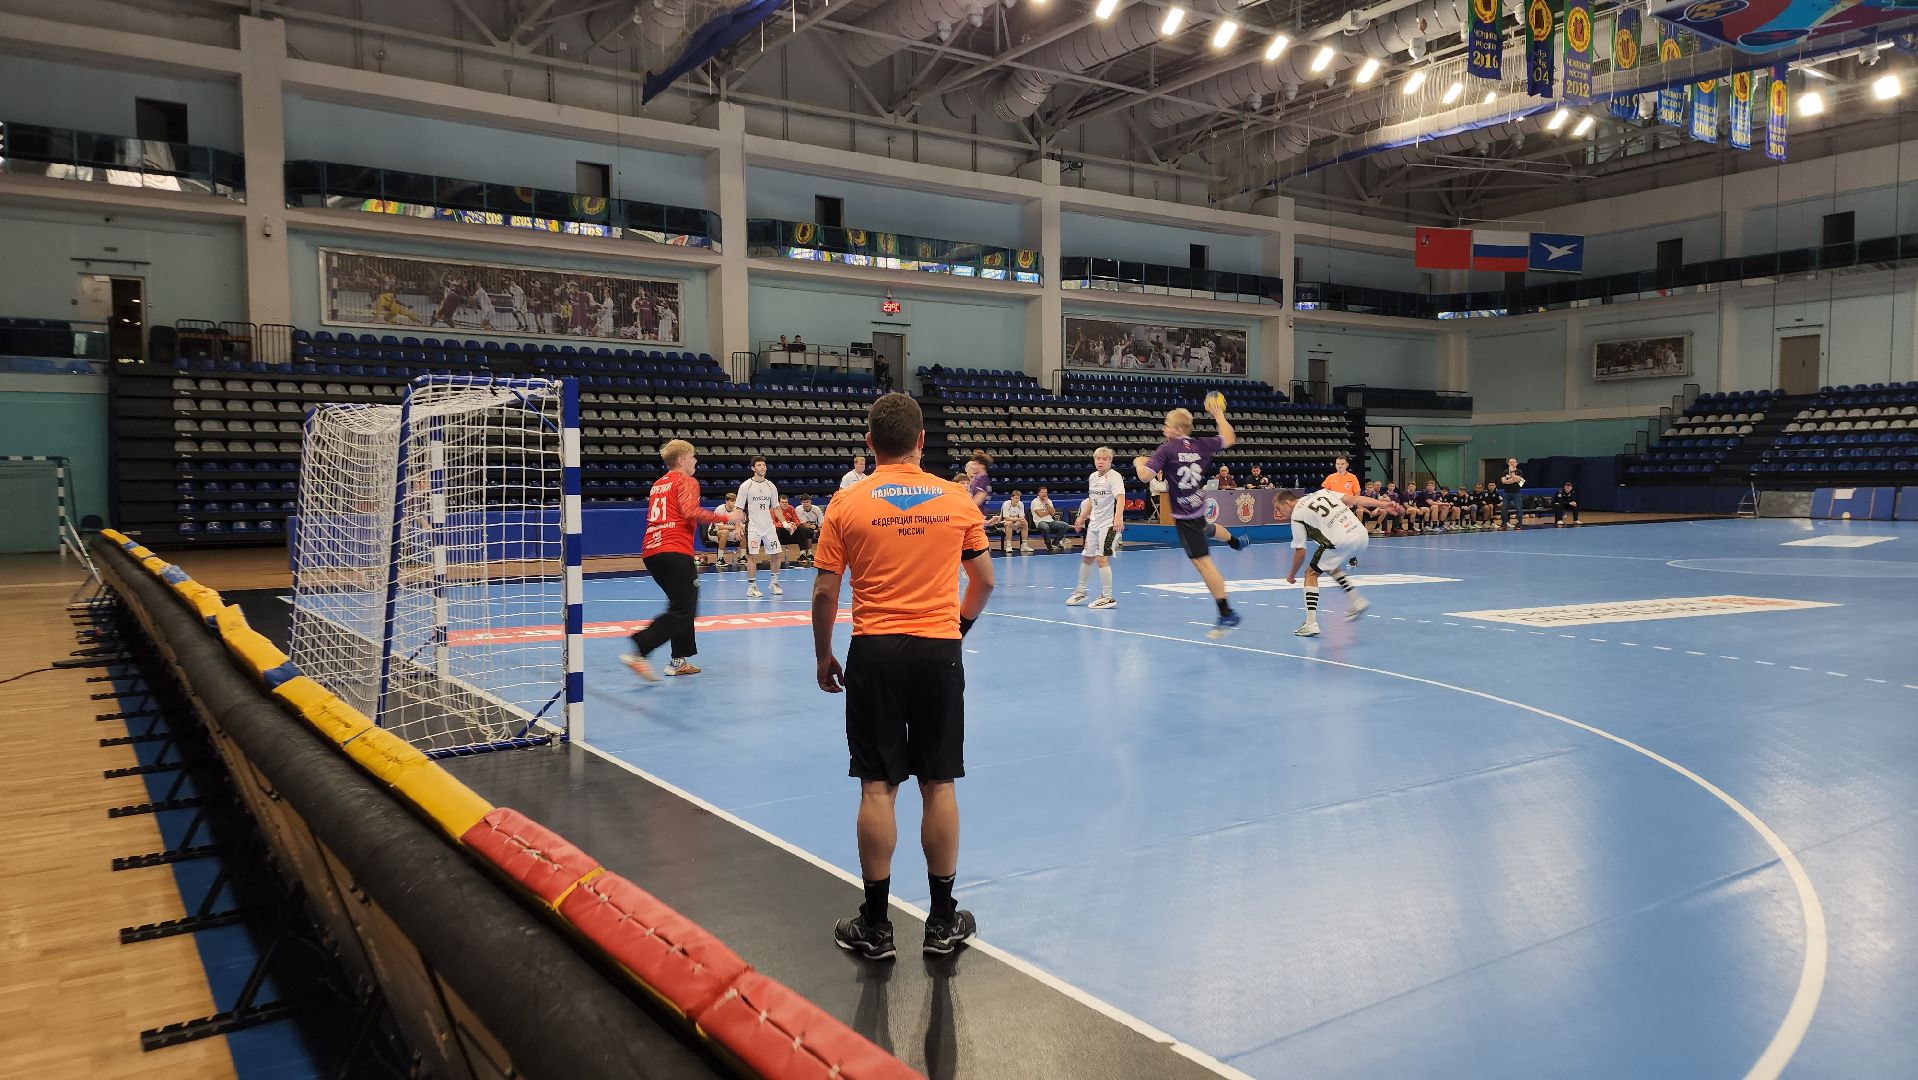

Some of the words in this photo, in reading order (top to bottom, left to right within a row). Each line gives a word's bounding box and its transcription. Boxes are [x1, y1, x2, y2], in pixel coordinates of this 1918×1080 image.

[1472, 50, 1499, 69] 2016
[1566, 79, 1590, 98] 2012
[648, 496, 667, 522] 61
[1308, 496, 1339, 518] 52
[871, 516, 913, 527] ФЕДЕРАЦИЯ
[898, 527, 925, 536] РОССИИ
